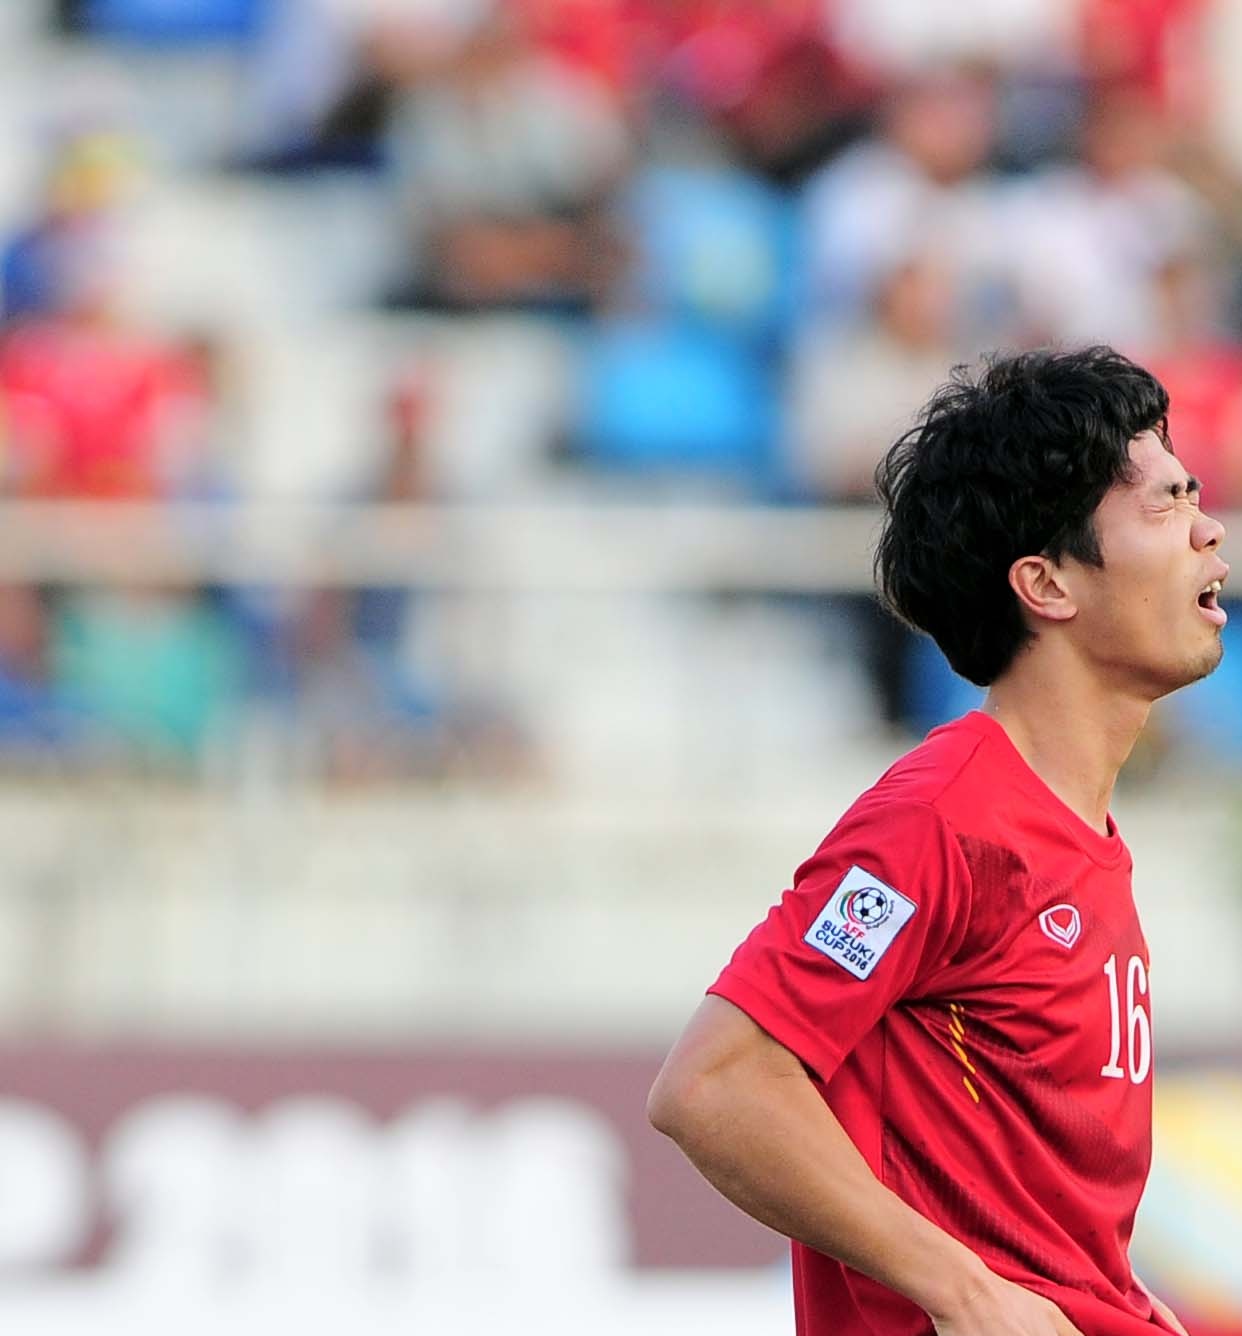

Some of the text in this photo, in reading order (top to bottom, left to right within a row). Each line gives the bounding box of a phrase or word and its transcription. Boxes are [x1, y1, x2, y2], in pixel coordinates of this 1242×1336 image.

[815, 930, 868, 970] CUP 2016
[821, 920, 875, 961] SUZUKI
[1101, 954, 1150, 1084] 16
